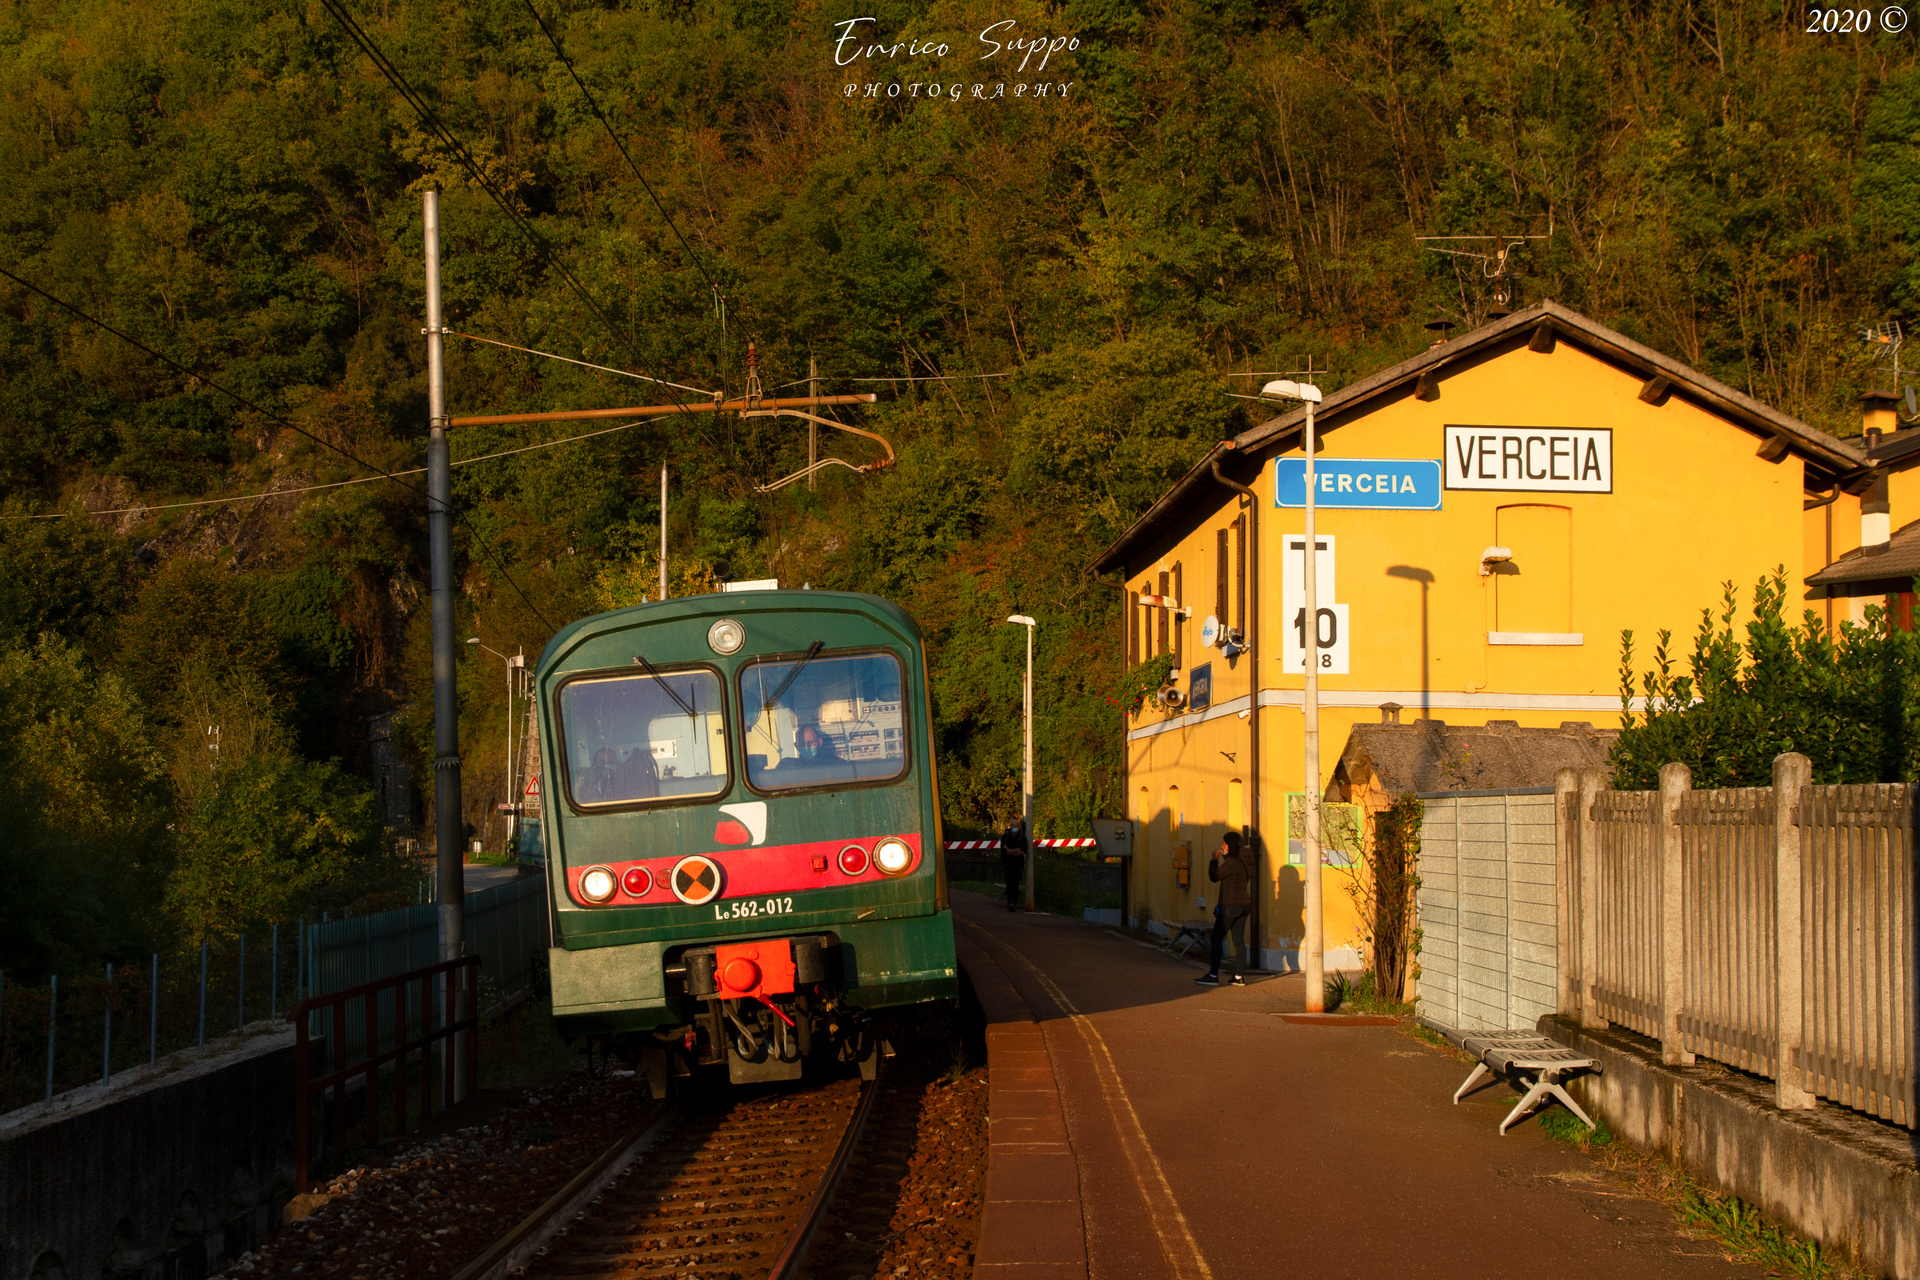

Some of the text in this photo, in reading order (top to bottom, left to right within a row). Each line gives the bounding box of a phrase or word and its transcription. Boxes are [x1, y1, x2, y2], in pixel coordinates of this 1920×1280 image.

[1456, 435, 1602, 481] VERCEIA
[1303, 473, 1416, 494] ERCEIA
[1294, 607, 1337, 649] 10
